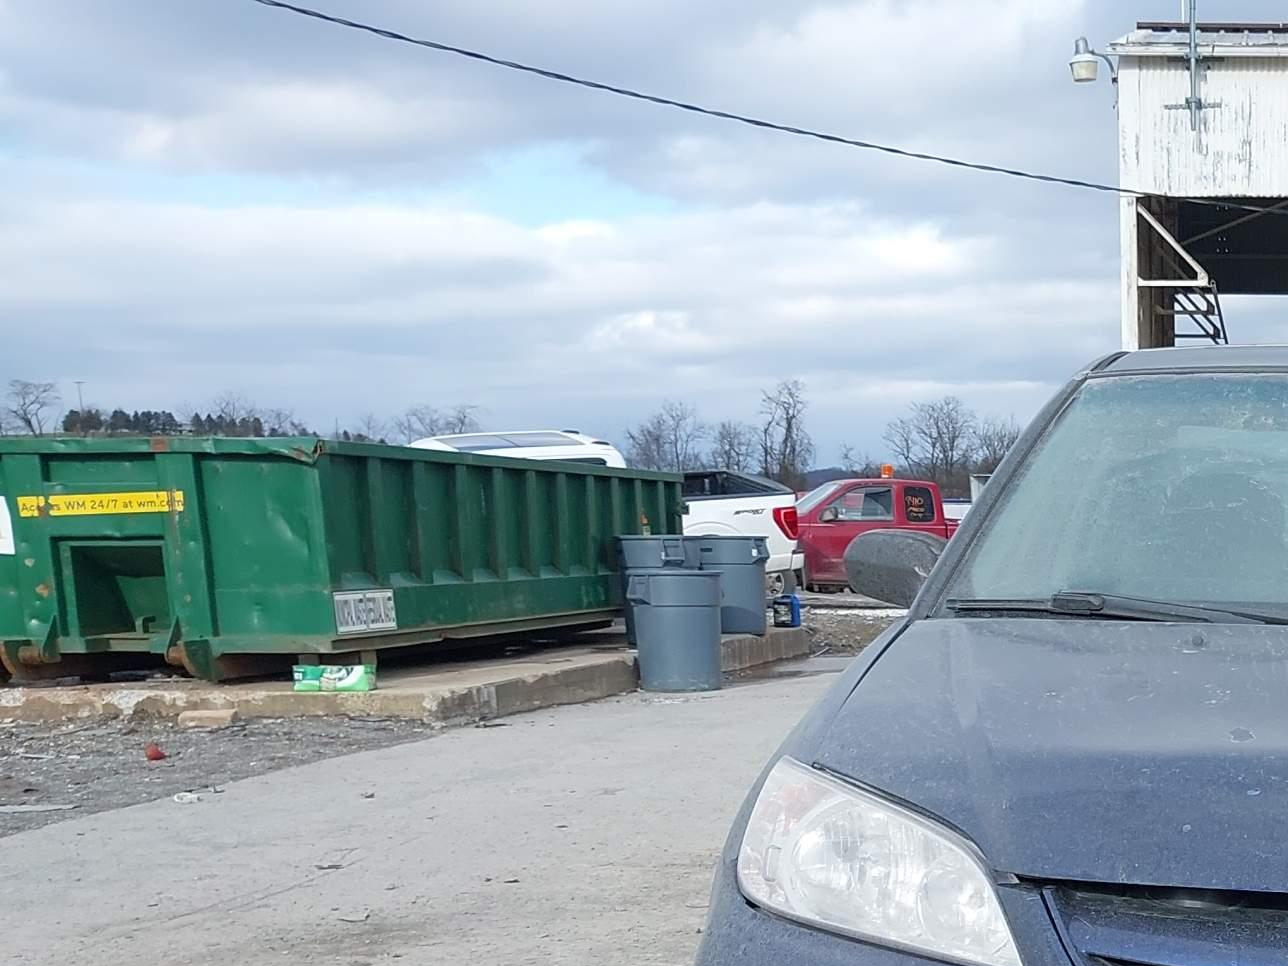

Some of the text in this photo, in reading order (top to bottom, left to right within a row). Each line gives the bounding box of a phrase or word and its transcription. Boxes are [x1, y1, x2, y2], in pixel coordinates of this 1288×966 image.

[64, 500, 86, 511] WM
[90, 498, 118, 510] 24/7
[122, 500, 134, 509] at
[137, 499, 184, 508] wm.cm
